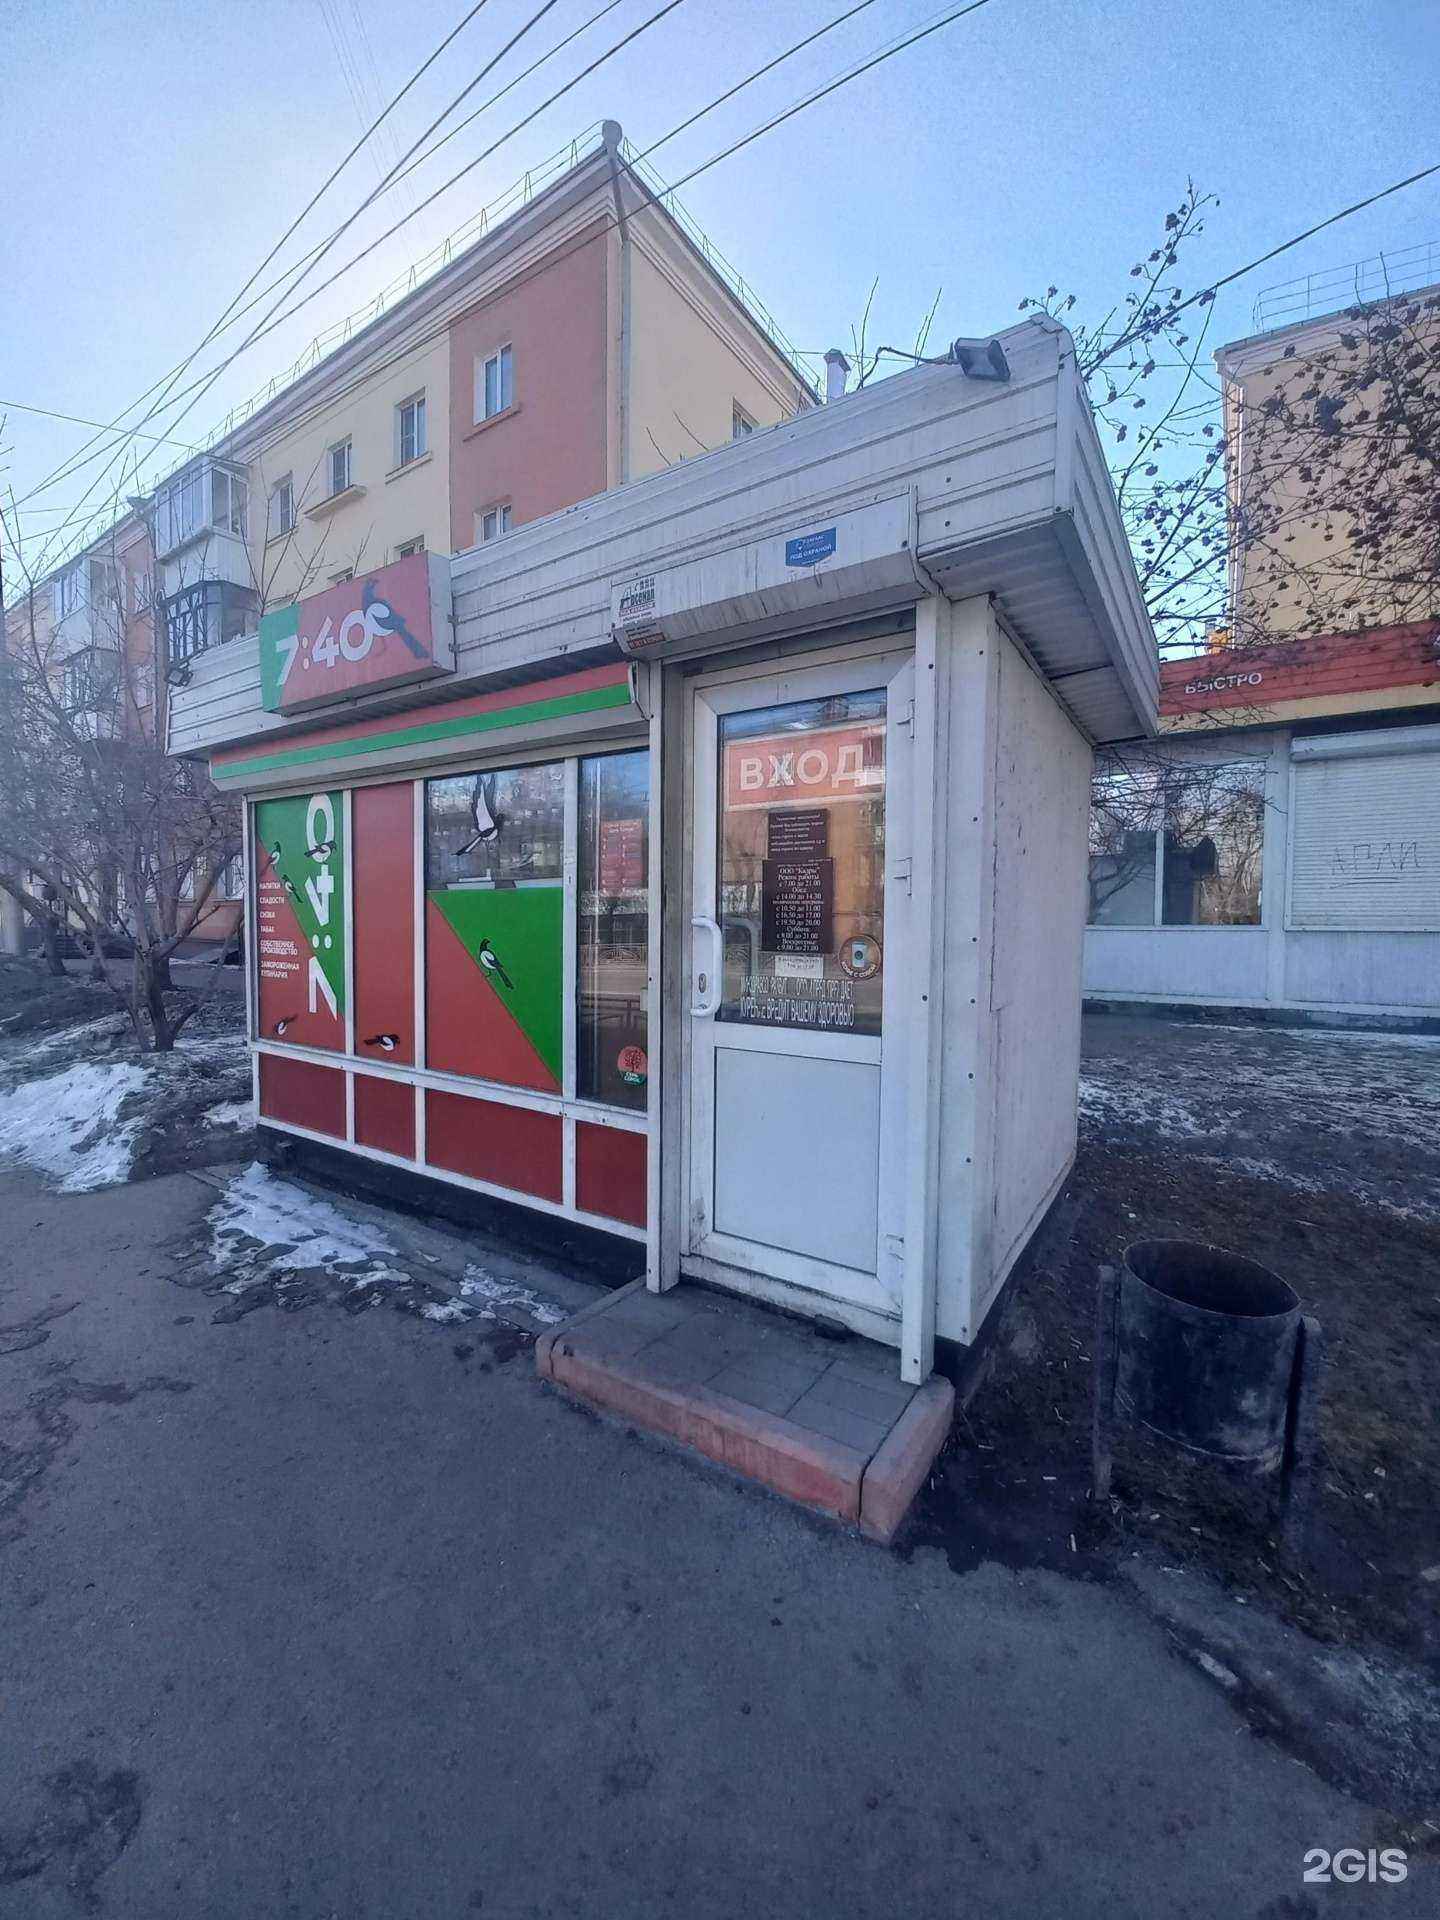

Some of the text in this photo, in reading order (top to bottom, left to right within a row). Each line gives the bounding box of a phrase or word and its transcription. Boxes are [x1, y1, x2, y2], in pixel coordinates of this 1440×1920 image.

[275, 610, 374, 687] 7:40
[740, 744, 864, 790] ВХОД
[818, 1001, 855, 1028] ЗДОРОВЬЮ
